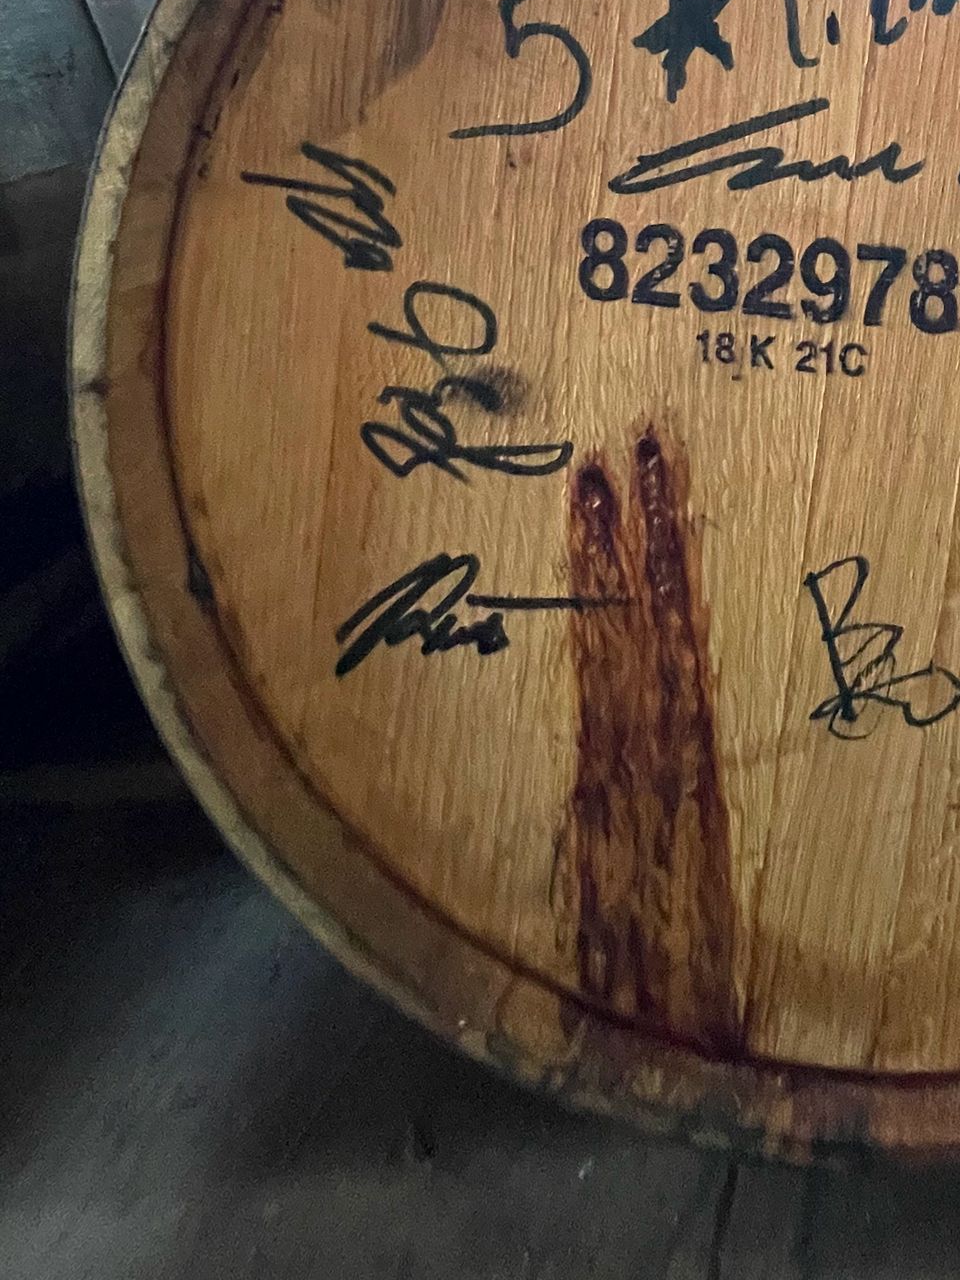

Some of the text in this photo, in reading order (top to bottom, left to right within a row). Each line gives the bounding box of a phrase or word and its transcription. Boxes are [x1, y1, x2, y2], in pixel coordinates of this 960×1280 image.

[577, 218, 960, 334] 8232978
[750, 335, 776, 369] K
[795, 341, 868, 377] 21C
